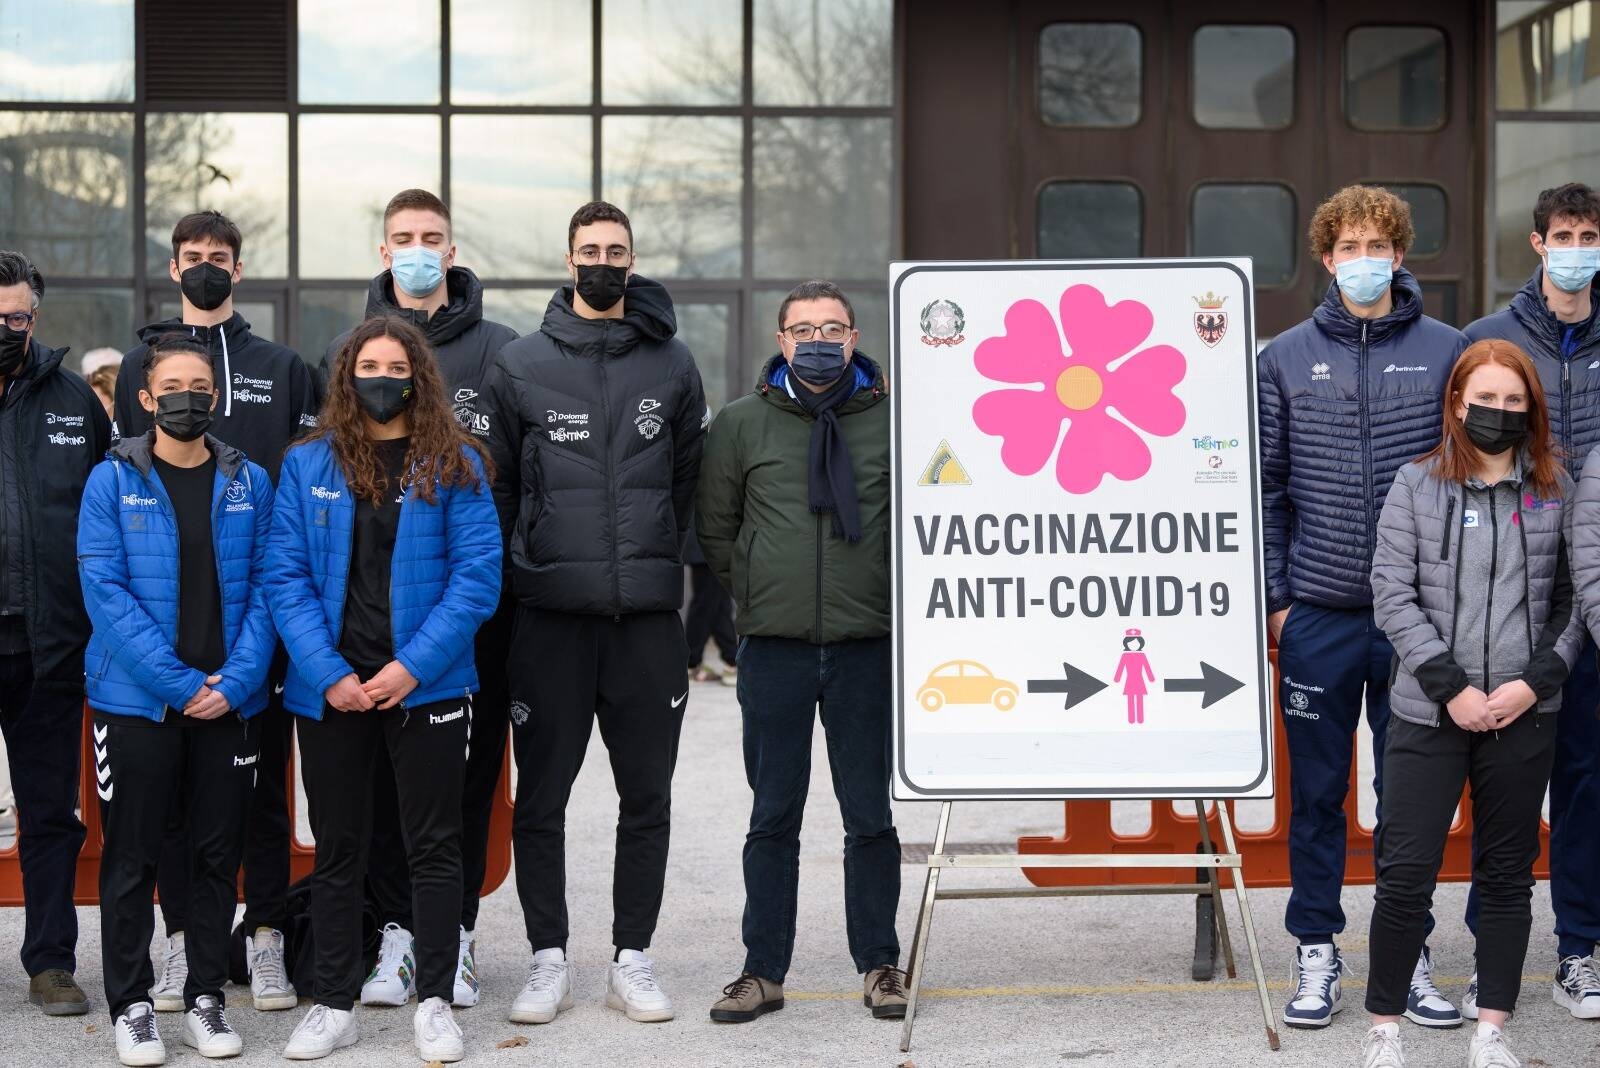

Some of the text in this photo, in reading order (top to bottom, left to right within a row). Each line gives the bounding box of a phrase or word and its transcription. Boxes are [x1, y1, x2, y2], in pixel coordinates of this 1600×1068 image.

[232, 389, 272, 404] TRENTINO
[48, 432, 86, 446] TRENTINO
[548, 427, 590, 442] TRENTINO
[1192, 435, 1239, 451] TRENTINO
[121, 493, 158, 506] TRENTINO
[311, 486, 342, 500] TRENTINO
[914, 512, 1239, 556] VACCINAZIONE
[926, 575, 1230, 618] ANTI-COVID19
[429, 706, 464, 725] hummel
[1284, 707, 1320, 720] NITRENTO
